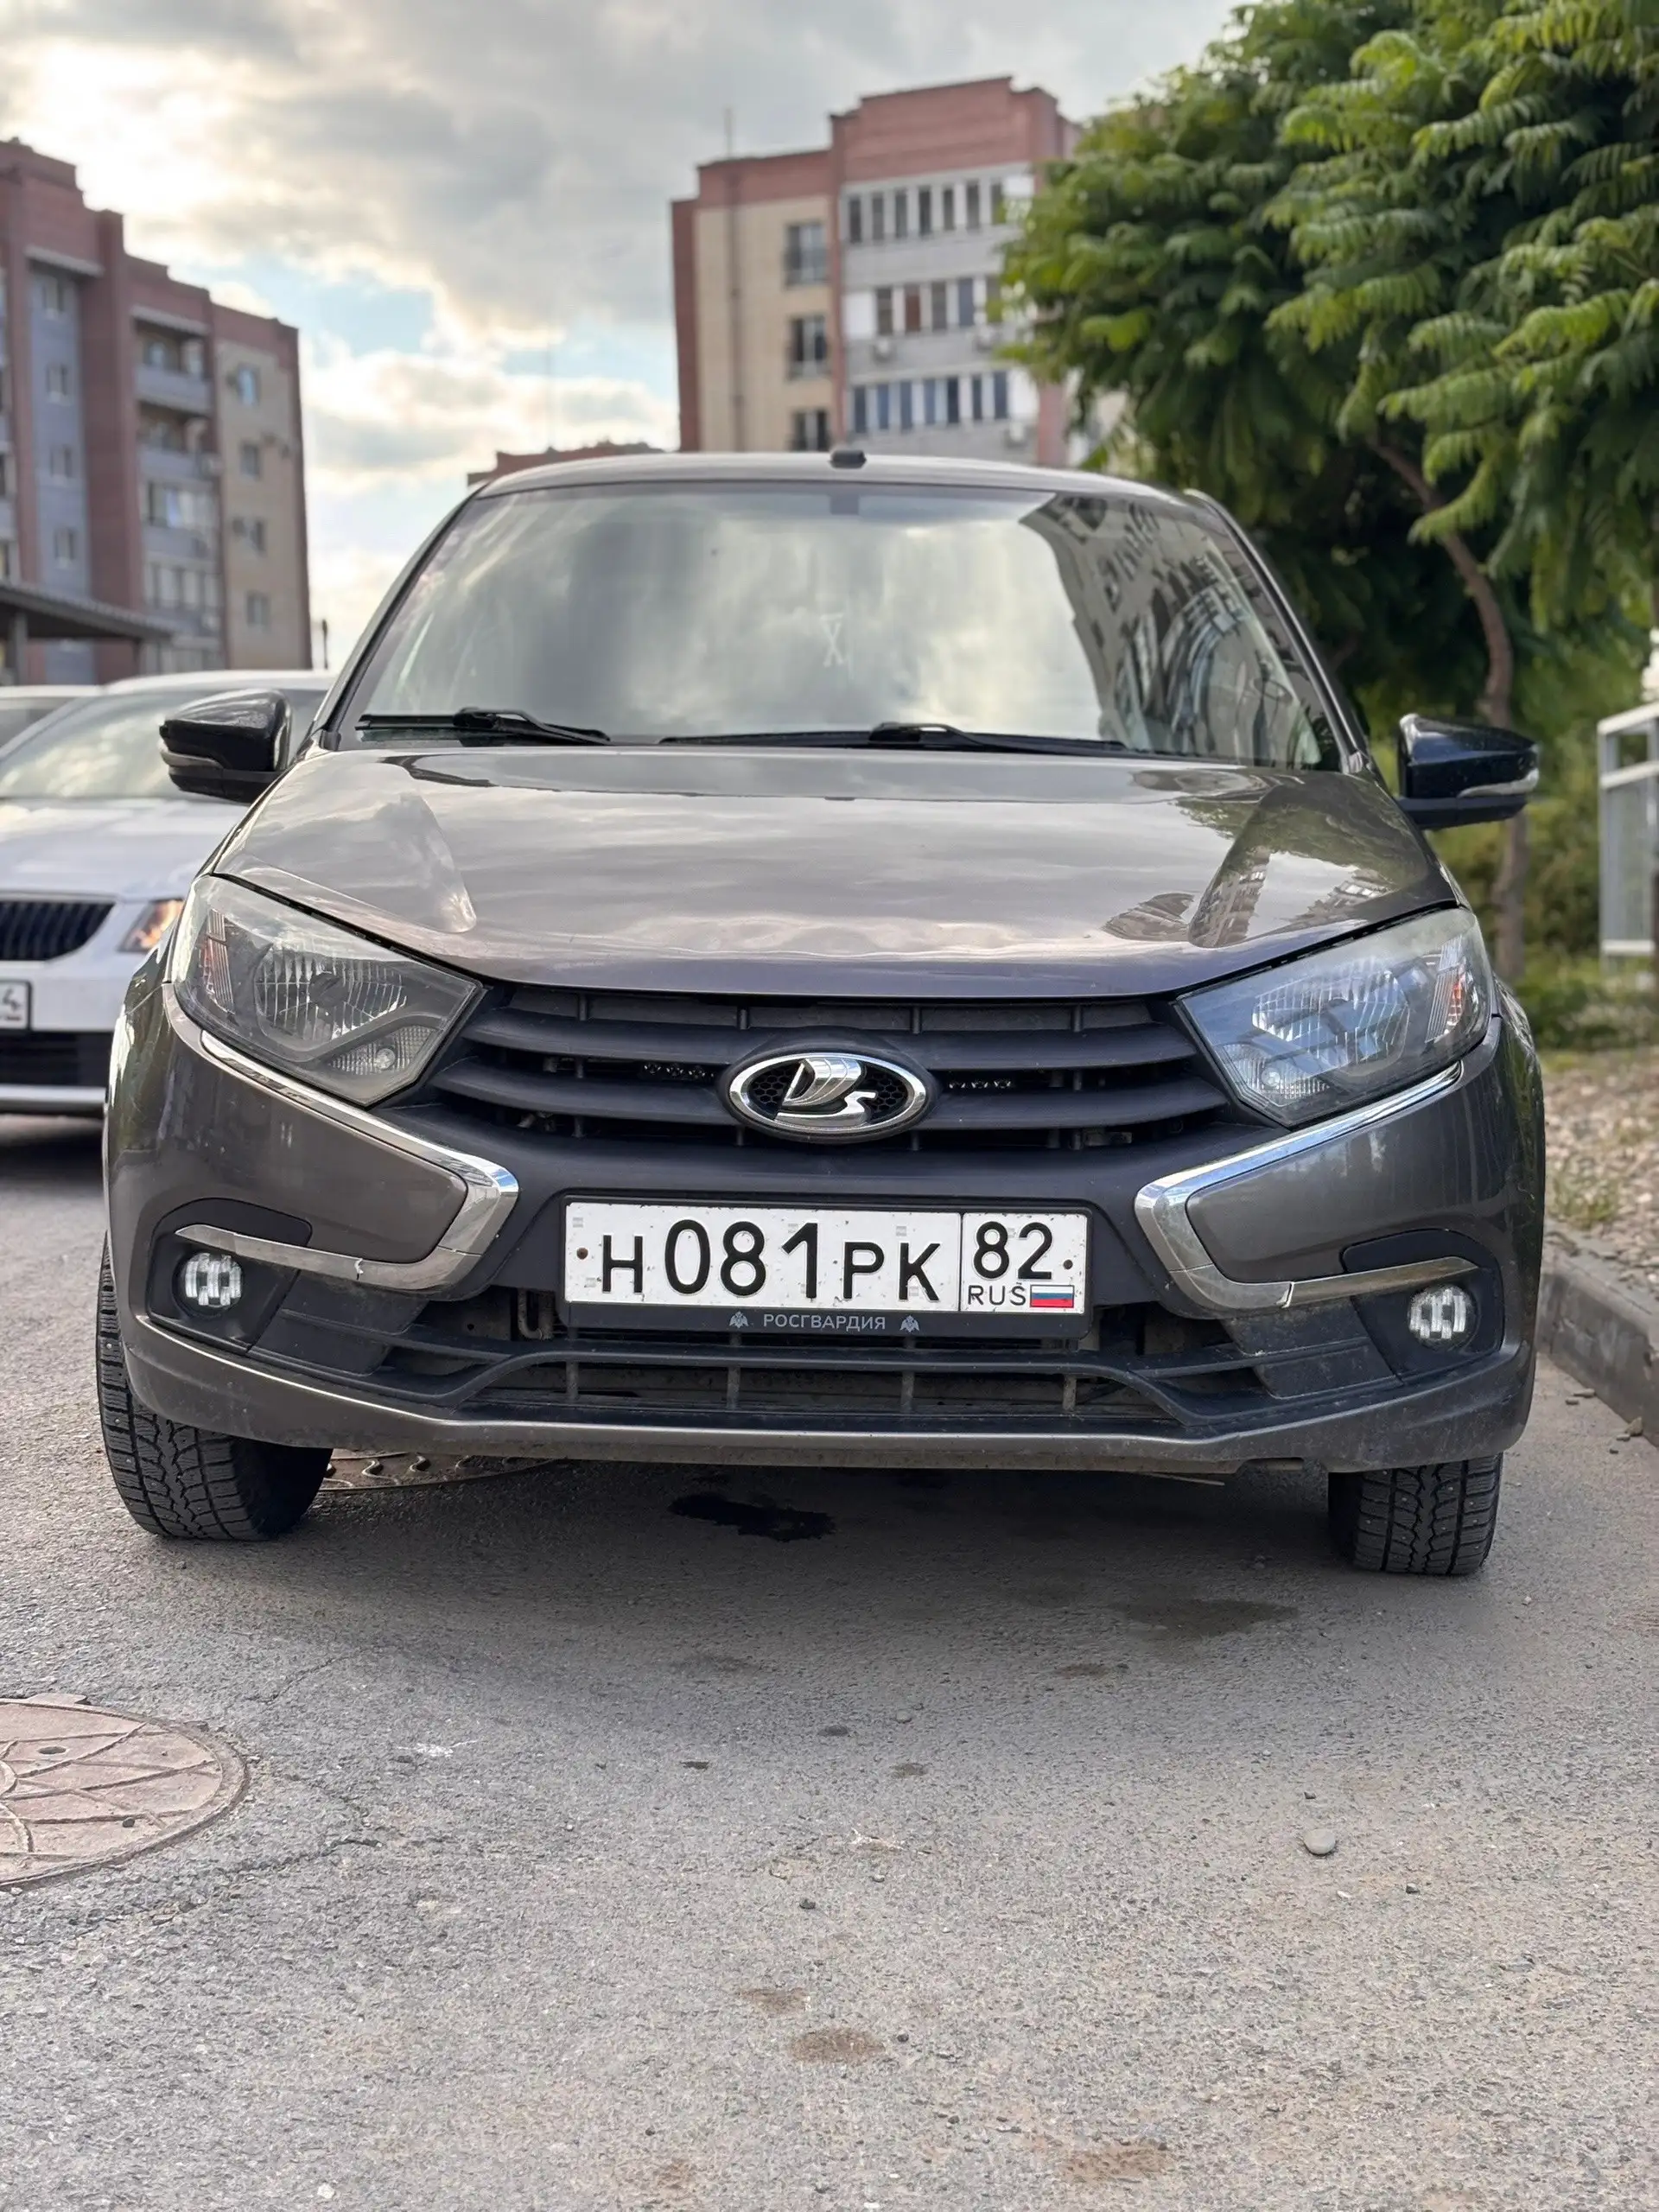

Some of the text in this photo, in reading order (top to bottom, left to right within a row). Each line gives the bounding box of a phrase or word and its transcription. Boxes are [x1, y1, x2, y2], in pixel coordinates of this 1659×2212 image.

[972, 1221, 1053, 1280] 82
[968, 1284, 1026, 1307] RUS
[763, 1313, 887, 1332] РОСГВАРДИЯ
